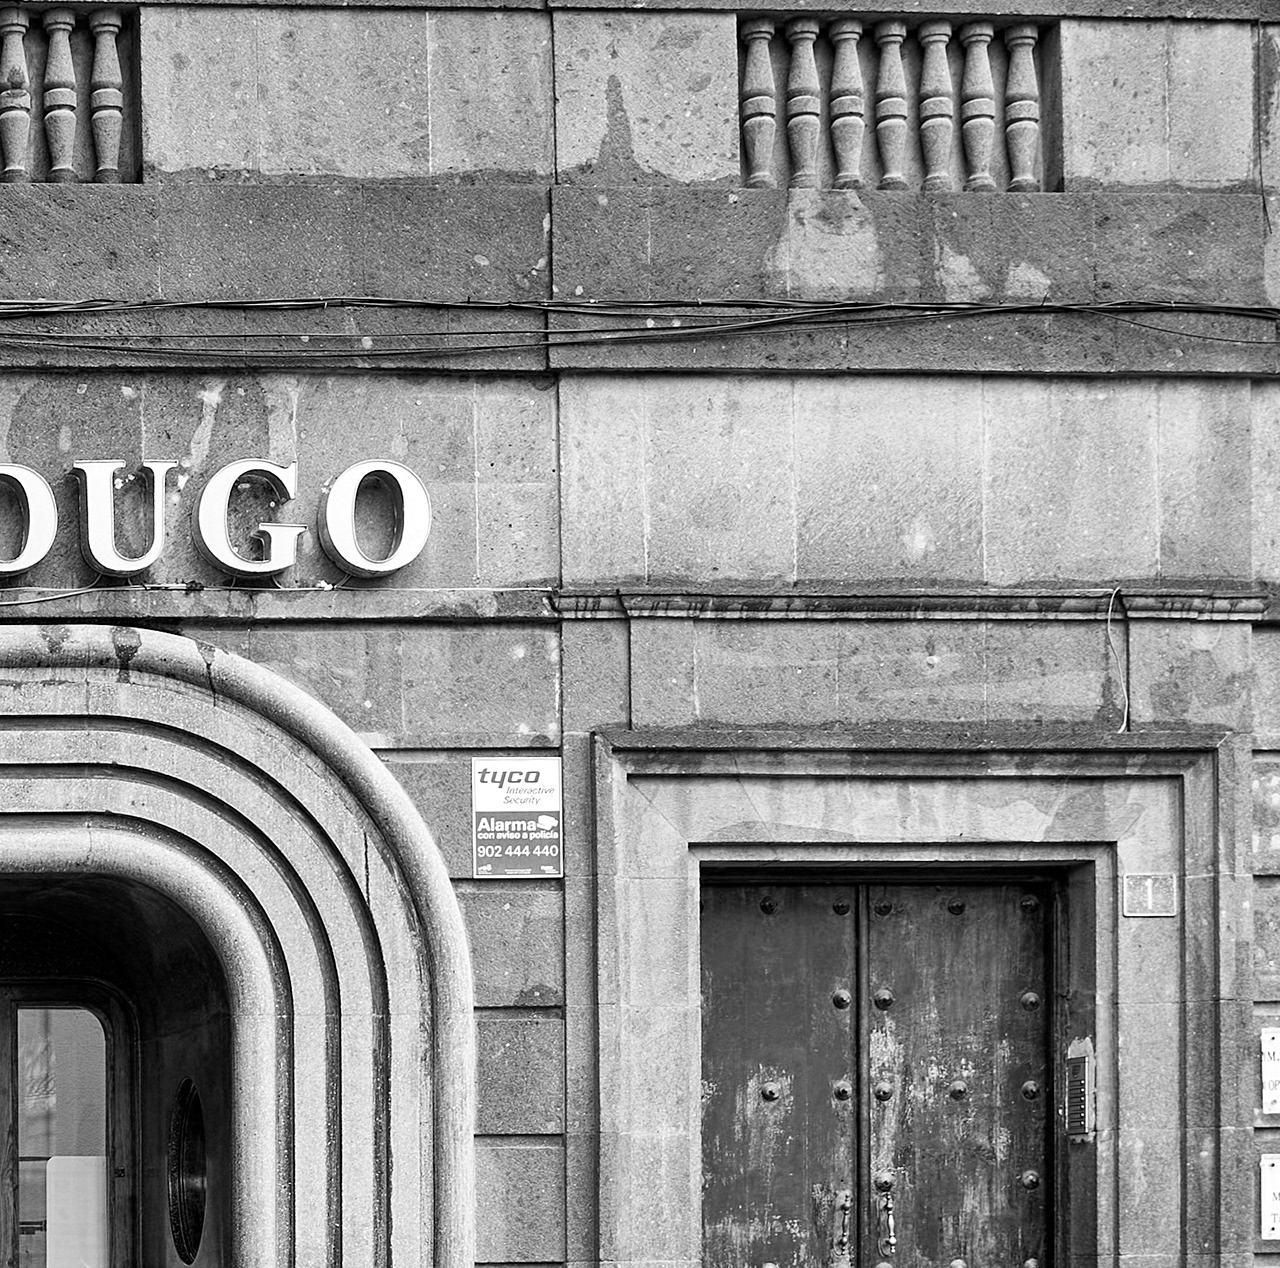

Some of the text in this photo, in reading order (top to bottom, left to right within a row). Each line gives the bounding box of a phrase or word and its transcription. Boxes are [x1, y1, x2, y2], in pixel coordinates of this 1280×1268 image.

[478, 768, 540, 788] tyco
[506, 786, 555, 795] Interactive
[503, 796, 541, 805] Security
[477, 817, 537, 832] Alarma
[496, 831, 521, 839] aviso
[477, 845, 559, 857] 902 444 440
[1145, 878, 1152, 910] 1
